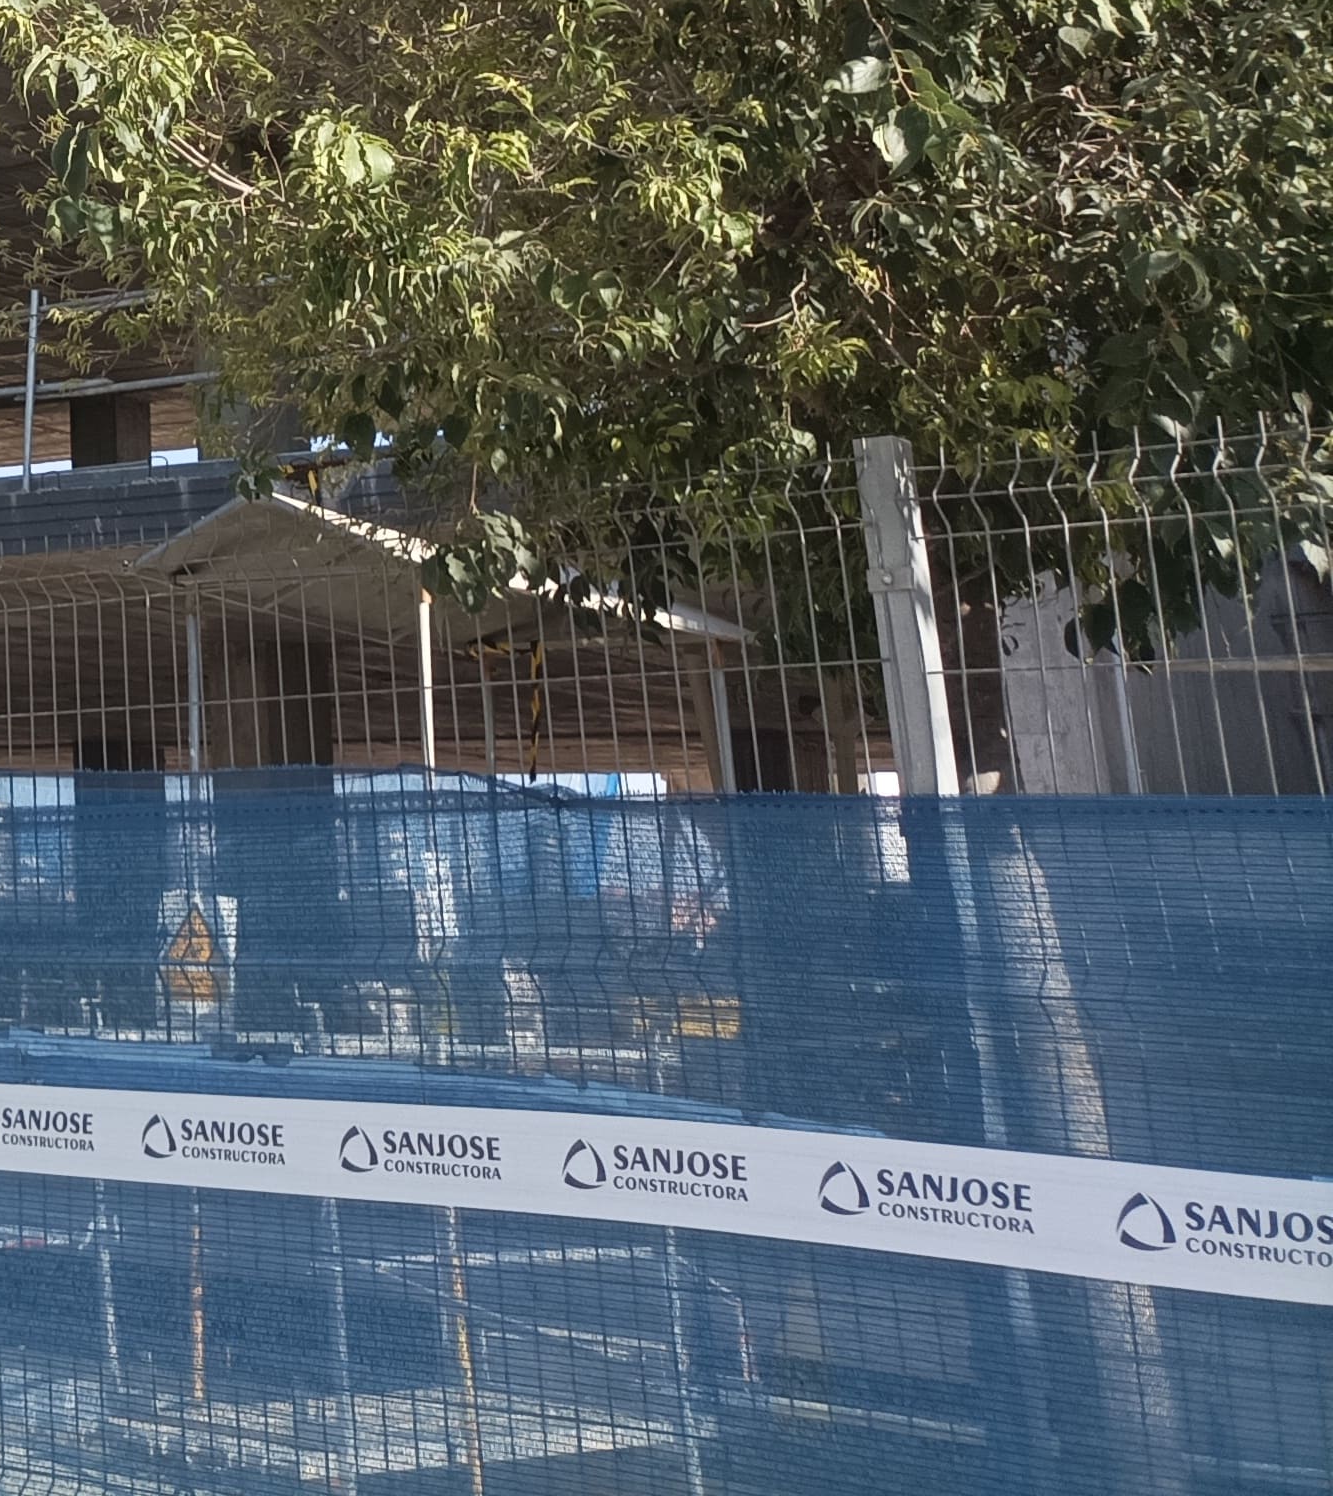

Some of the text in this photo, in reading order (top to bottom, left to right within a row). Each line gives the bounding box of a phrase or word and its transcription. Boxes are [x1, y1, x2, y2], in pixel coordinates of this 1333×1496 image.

[1, 1107, 94, 1134] SANJOSE
[181, 1118, 285, 1147] SANJOSE
[2, 1133, 95, 1152] CONSTRUCTORA
[182, 1146, 286, 1166] CONSTRUCTORA
[383, 1130, 502, 1162] SANJOSE
[384, 1159, 502, 1180] CONSTRUCTORA
[613, 1144, 748, 1181] SANJOSE
[613, 1175, 749, 1202] CONSTRUCTORA
[876, 1168, 1033, 1213] SANJOSE
[878, 1201, 1035, 1235] CONSTRUCTORA
